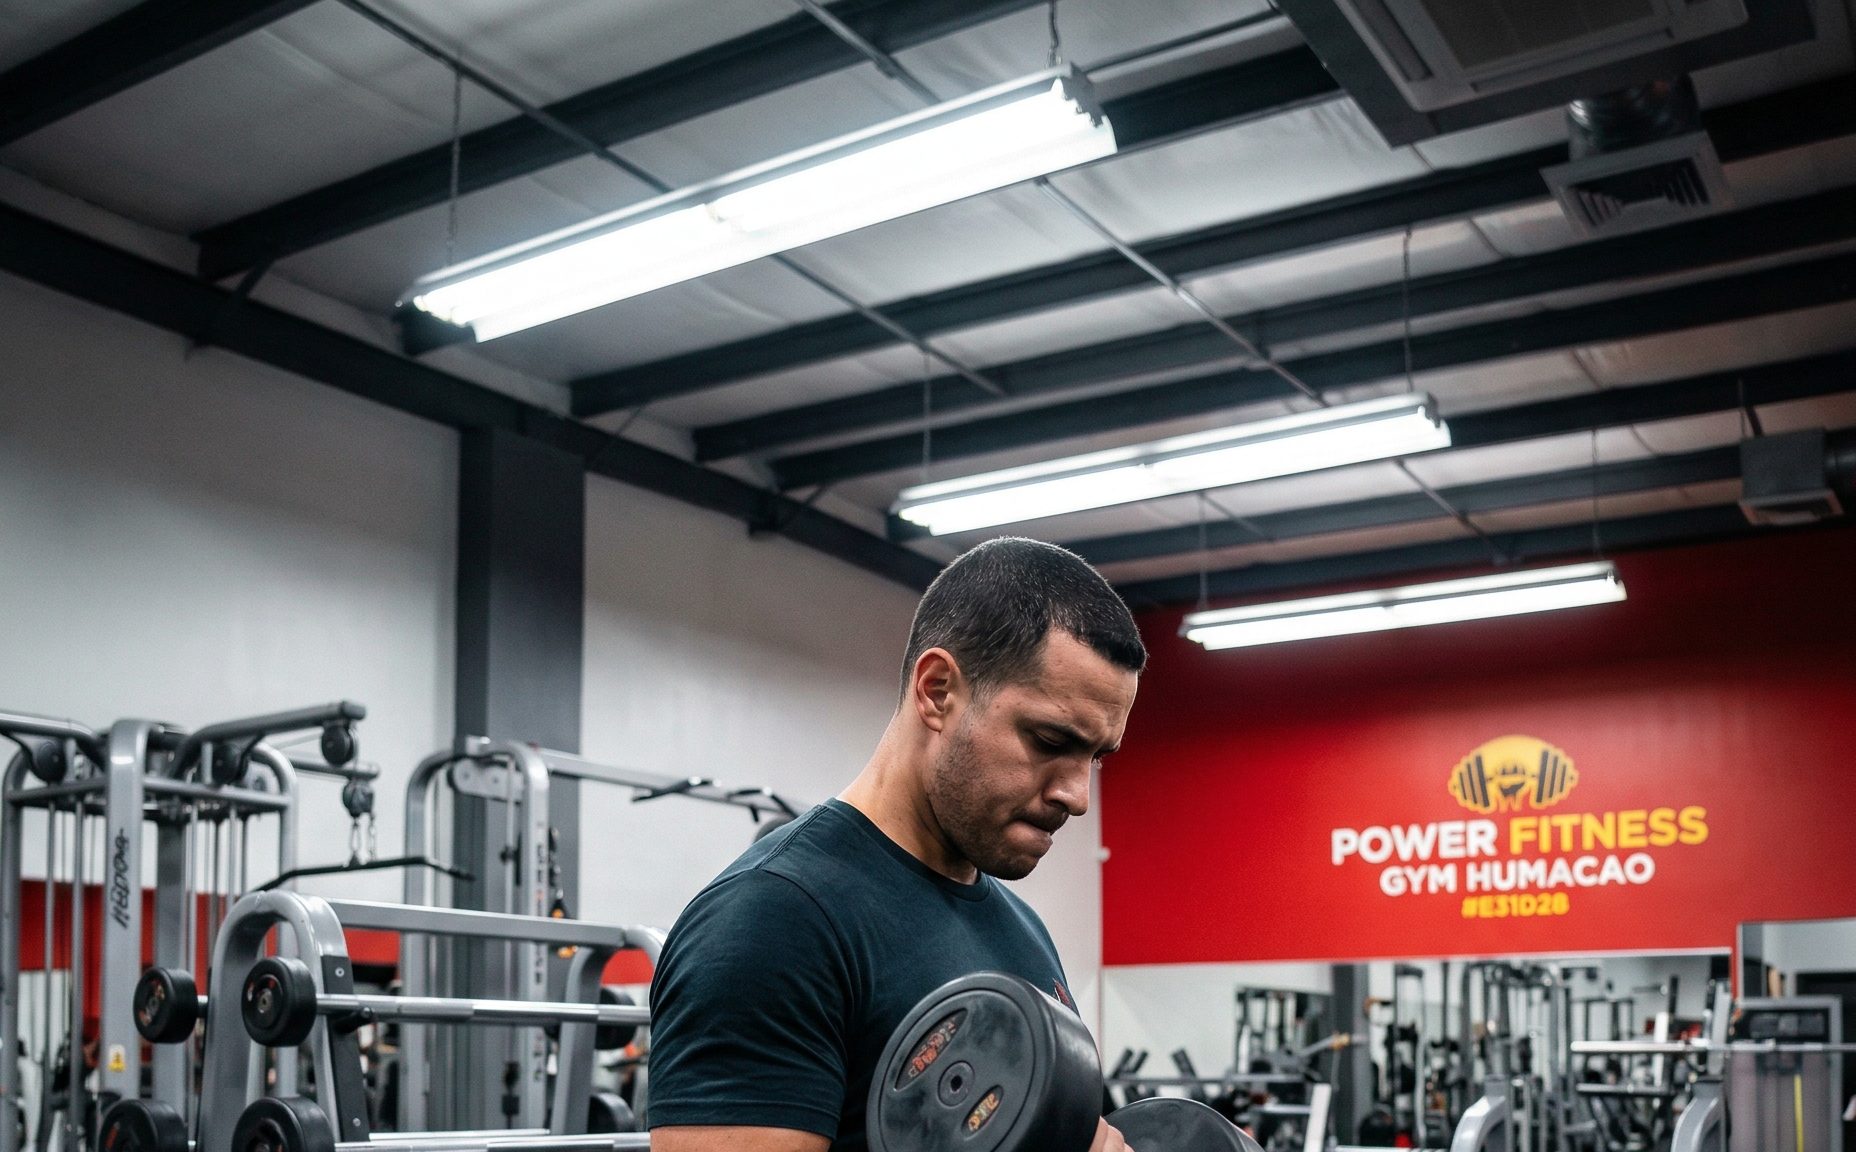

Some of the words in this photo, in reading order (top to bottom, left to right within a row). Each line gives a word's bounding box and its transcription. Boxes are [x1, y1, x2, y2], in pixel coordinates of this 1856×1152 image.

[1331, 819, 1498, 866] POWER
[1510, 806, 1709, 854] FITNESS
[1379, 864, 1457, 896] GYM
[1466, 853, 1656, 892] HUMACAO
